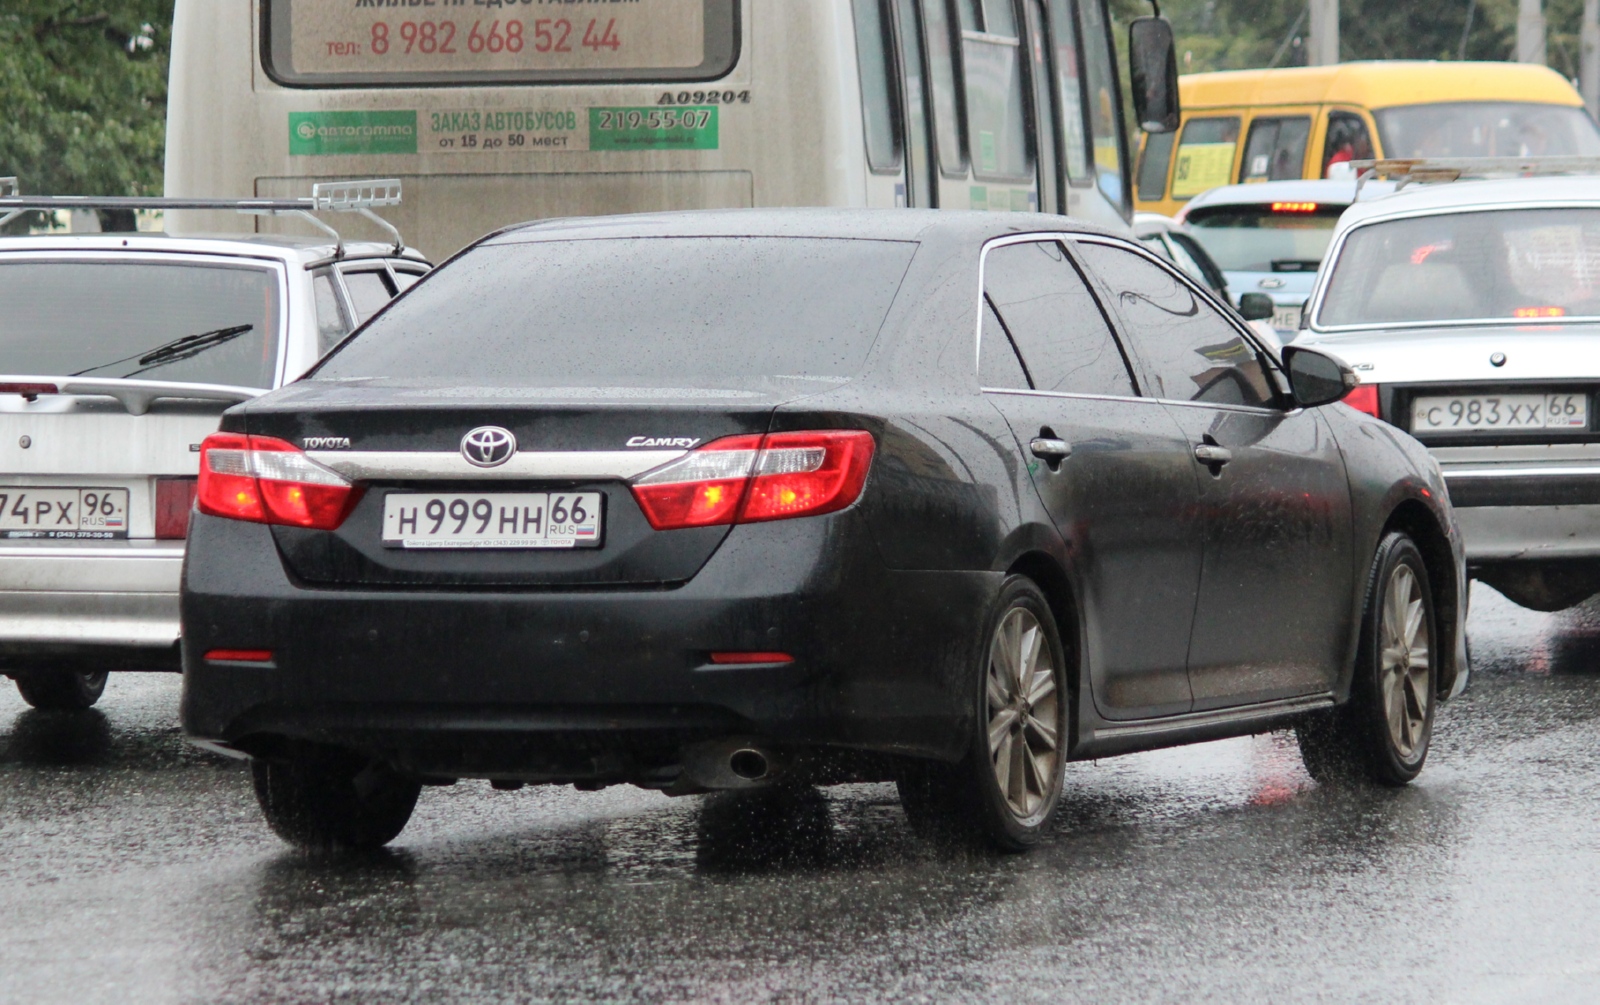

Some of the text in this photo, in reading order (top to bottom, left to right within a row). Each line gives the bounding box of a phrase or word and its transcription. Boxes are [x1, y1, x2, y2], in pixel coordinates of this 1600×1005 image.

[325, 17, 620, 56] тел: 8 982 668 52 44
[657, 90, 750, 105] A09204
[431, 111, 576, 131] ЗАКАЗ АВТОБУСОВ
[599, 110, 710, 129] 219-55-07
[439, 134, 568, 149] от 15 до 50 мест
[1549, 396, 1577, 416] 66
[1547, 417, 1568, 425] RUS
[303, 437, 351, 449] TOYOTA
[626, 436, 701, 448] CAMRY
[84, 493, 114, 516] 96
[551, 496, 587, 524] 66
[81, 517, 105, 526] RUS
[549, 525, 575, 535] RUS
